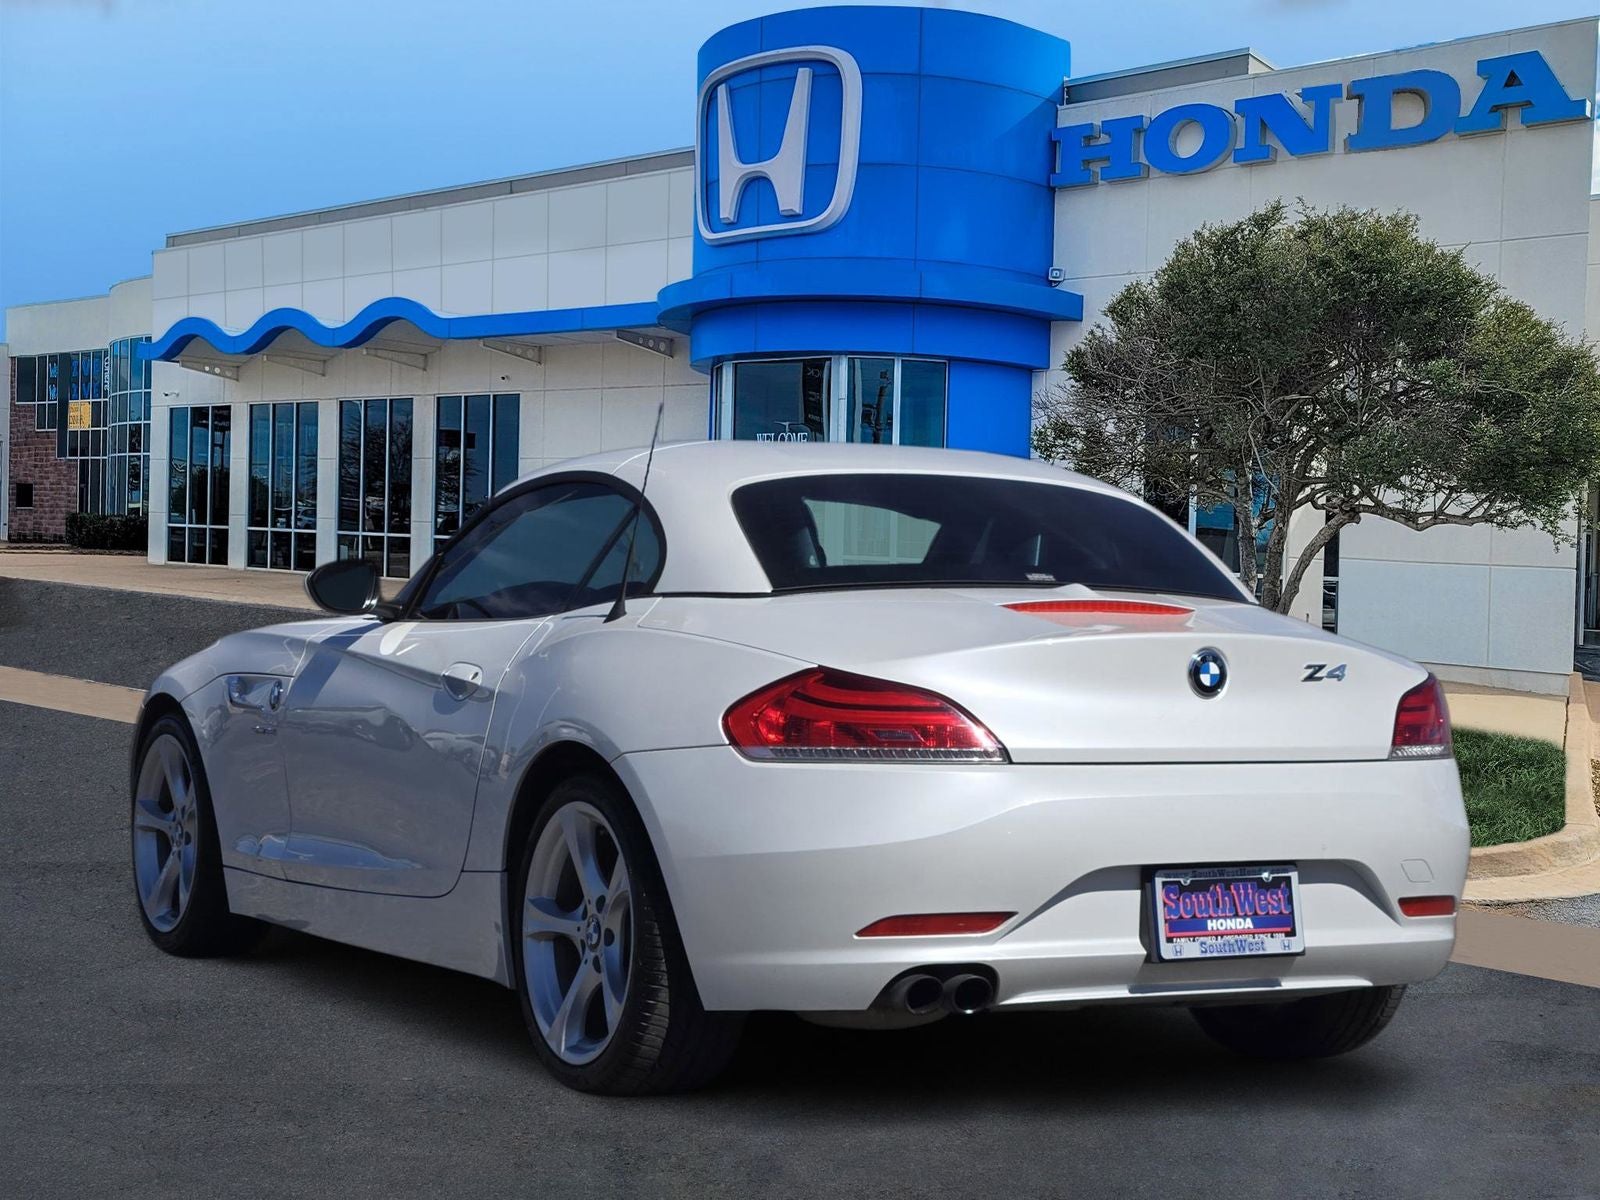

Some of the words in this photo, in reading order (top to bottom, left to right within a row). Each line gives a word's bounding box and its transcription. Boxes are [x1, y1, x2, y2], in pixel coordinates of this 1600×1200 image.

[1050, 50, 1591, 189] HONDA
[1301, 663, 1347, 682] Z4
[1162, 882, 1291, 919] SouthWest
[1207, 918, 1254, 930] HONDA
[1200, 939, 1266, 954] SouthWest
